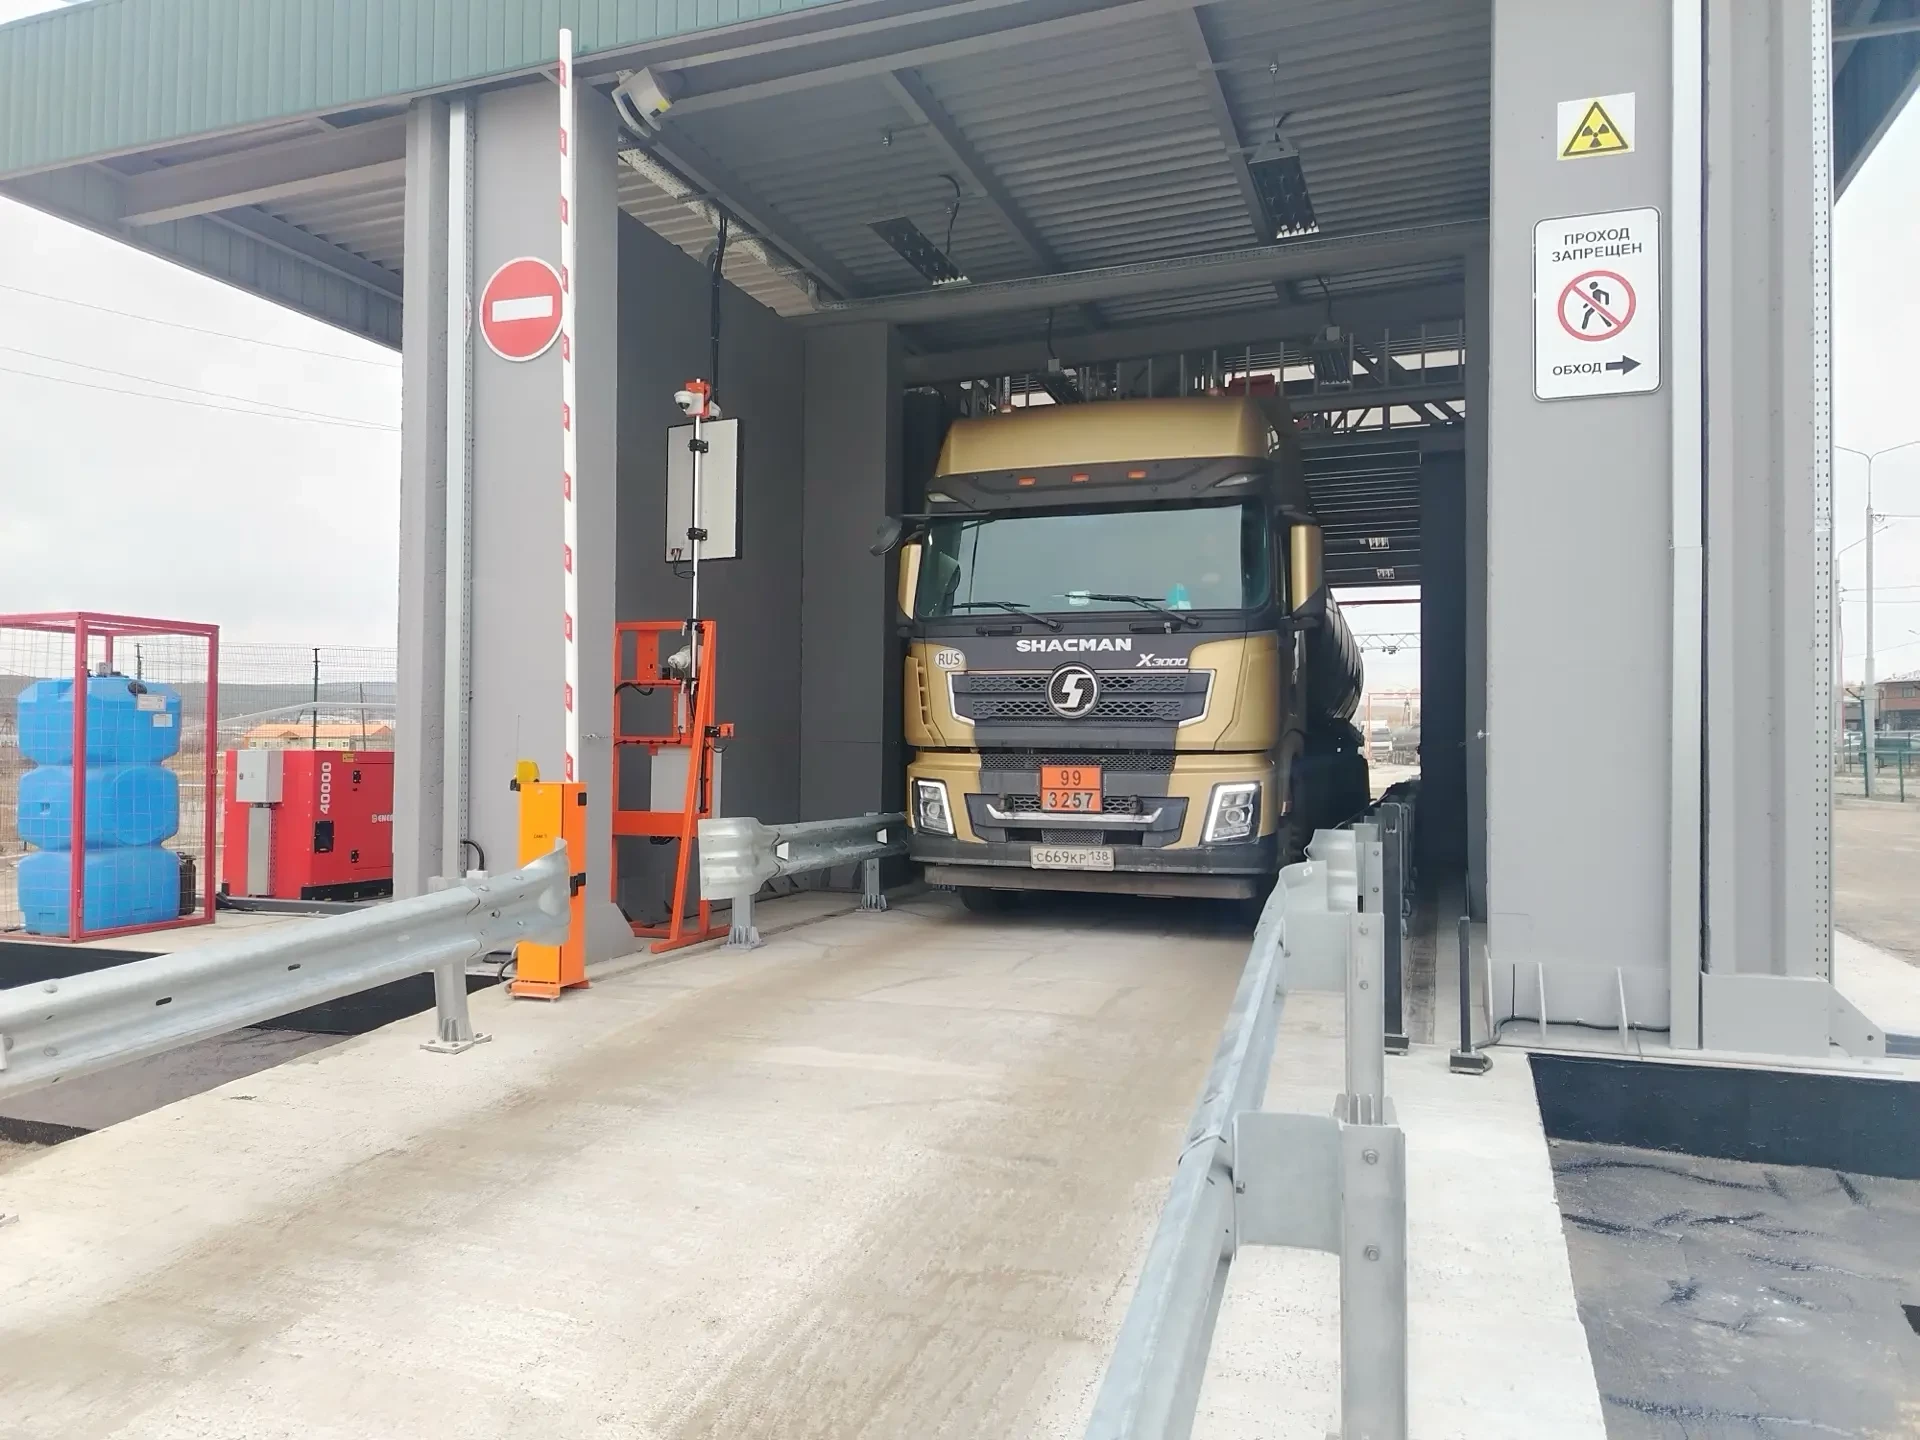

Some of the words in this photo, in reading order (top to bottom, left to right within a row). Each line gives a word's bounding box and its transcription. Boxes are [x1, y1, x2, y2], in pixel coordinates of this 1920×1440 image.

[1563, 227, 1630, 245] ПРОХОД
[1552, 242, 1642, 262] ЗАПРЕЩЕН
[1552, 362, 1602, 376] ОБХОД
[1016, 638, 1132, 652] SHACMAN
[938, 653, 960, 665] RUS
[1135, 653, 1188, 667] X3000
[1060, 770, 1081, 786] 99
[320, 761, 332, 815] 40000
[1049, 791, 1094, 809] 3257
